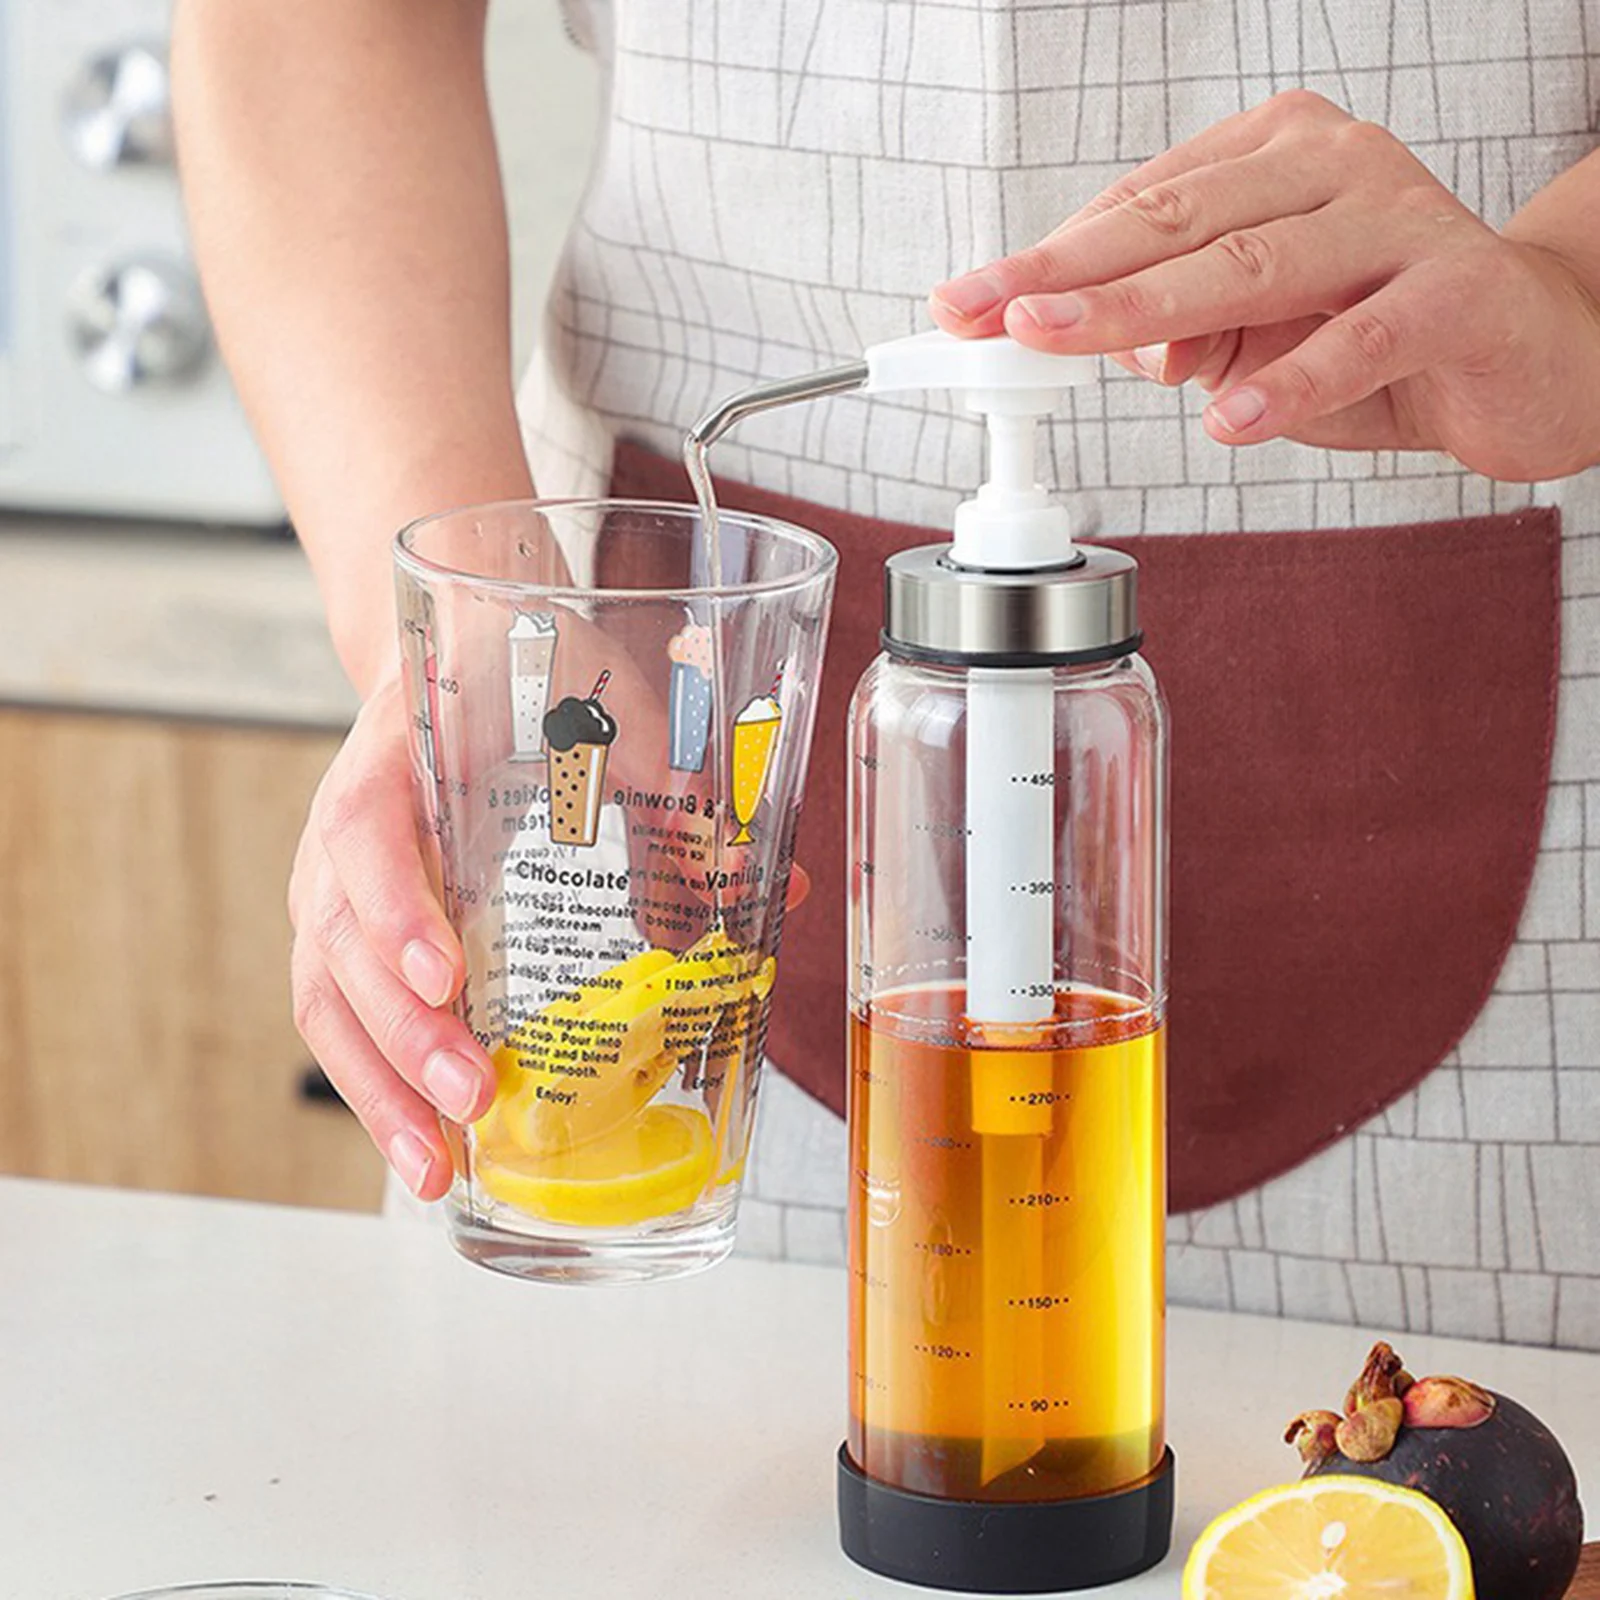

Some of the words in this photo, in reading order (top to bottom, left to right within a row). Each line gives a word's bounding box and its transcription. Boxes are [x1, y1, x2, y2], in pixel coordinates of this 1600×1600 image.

[1030, 773, 1055, 787] 450
[516, 860, 629, 890] Chocolate
[705, 866, 764, 891] Vanilla
[1029, 882, 1054, 895] 390
[568, 903, 637, 919] chocolate
[557, 919, 602, 932] cream
[554, 946, 595, 960] whole
[598, 950, 627, 961] milk
[556, 974, 624, 990] chocolate
[1029, 984, 1054, 997] 330
[661, 1005, 711, 1018] Measure
[552, 1015, 629, 1033] ingredients
[530, 1028, 557, 1043] cup.
[561, 1031, 592, 1046] Pour
[595, 1036, 623, 1049] into
[504, 1037, 551, 1055] blender
[553, 1048, 579, 1062] and
[581, 1050, 620, 1065] blend
[517, 1058, 546, 1072] until
[549, 1063, 601, 1079] smooth.
[535, 1085, 578, 1106] Enjoy!
[1028, 1091, 1055, 1105] 270
[1027, 1193, 1053, 1206] 210
[1027, 1296, 1052, 1309] 150
[930, 1346, 954, 1359] 120
[1030, 1399, 1049, 1412] 90
